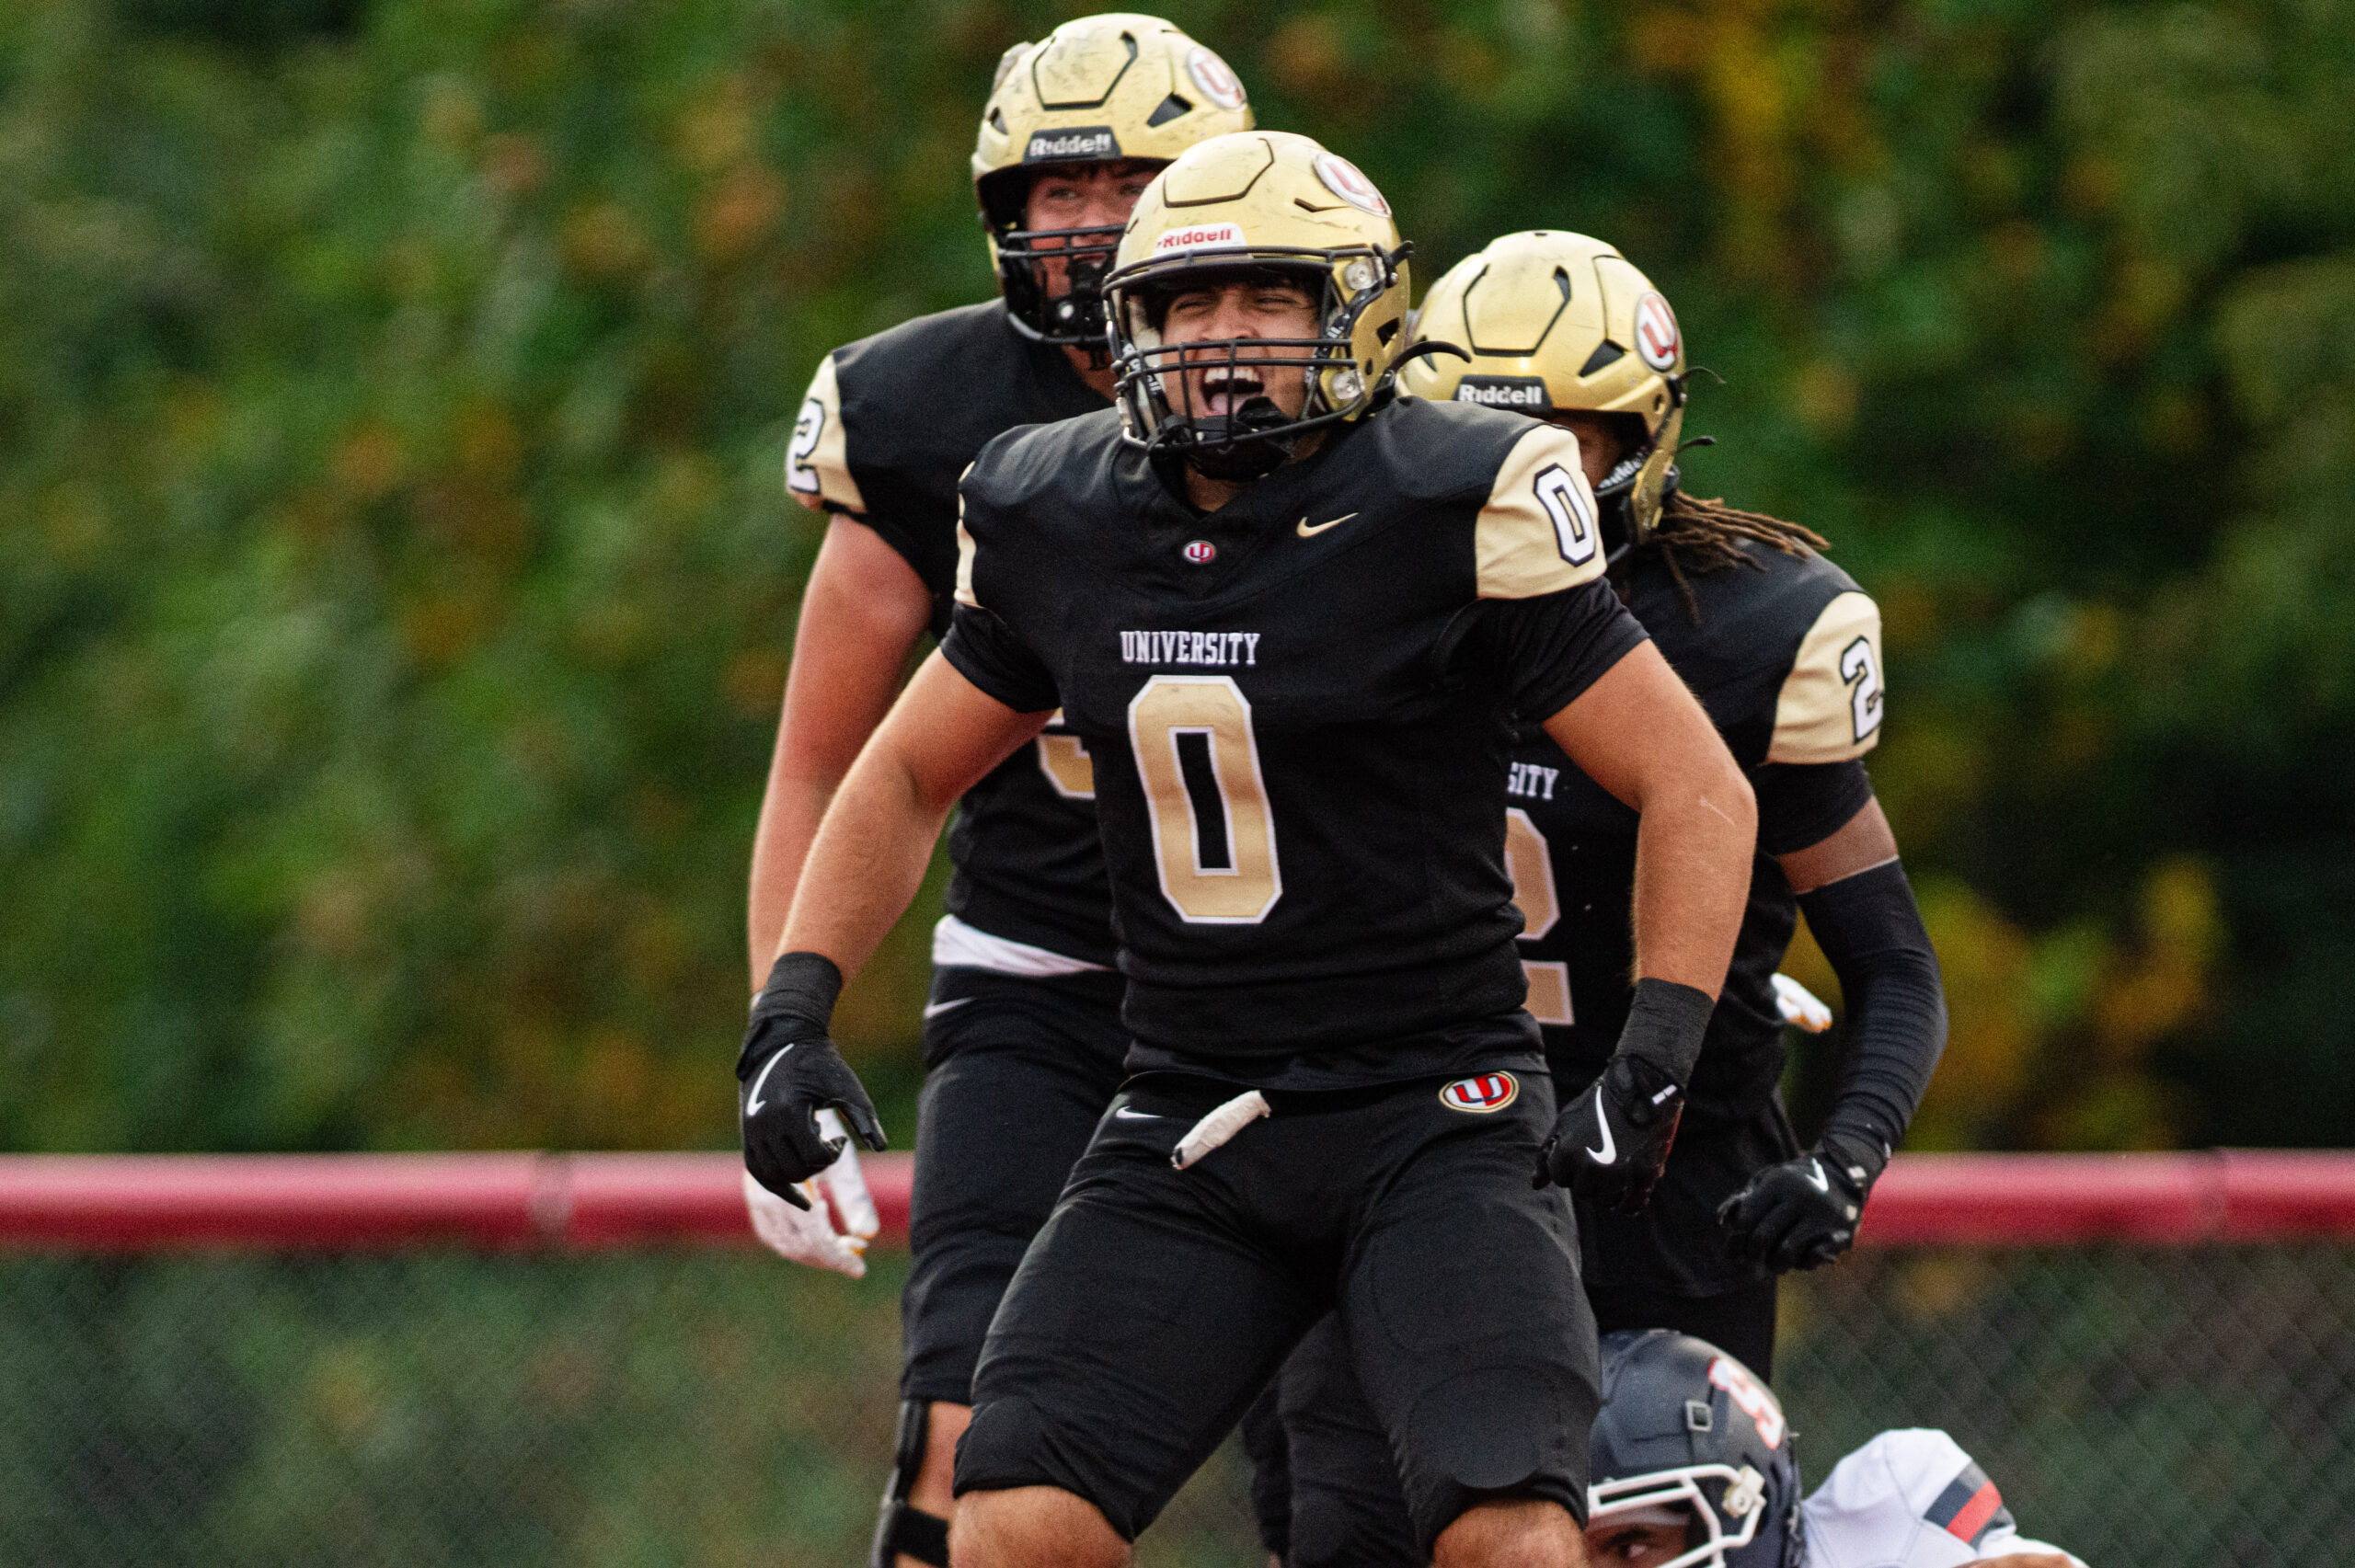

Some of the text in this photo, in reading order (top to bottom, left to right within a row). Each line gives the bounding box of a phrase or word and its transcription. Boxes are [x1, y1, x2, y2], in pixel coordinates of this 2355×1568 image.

[1030, 134, 1111, 156] Riddell
[1163, 228, 1231, 248] Riddell
[1459, 383, 1542, 405] Riddell
[787, 397, 826, 495] 2
[1533, 463, 1596, 567] 0
[1120, 631, 1260, 665] UNIVERSITY
[1840, 635, 1884, 745] 2
[1128, 674, 1283, 924] 0
